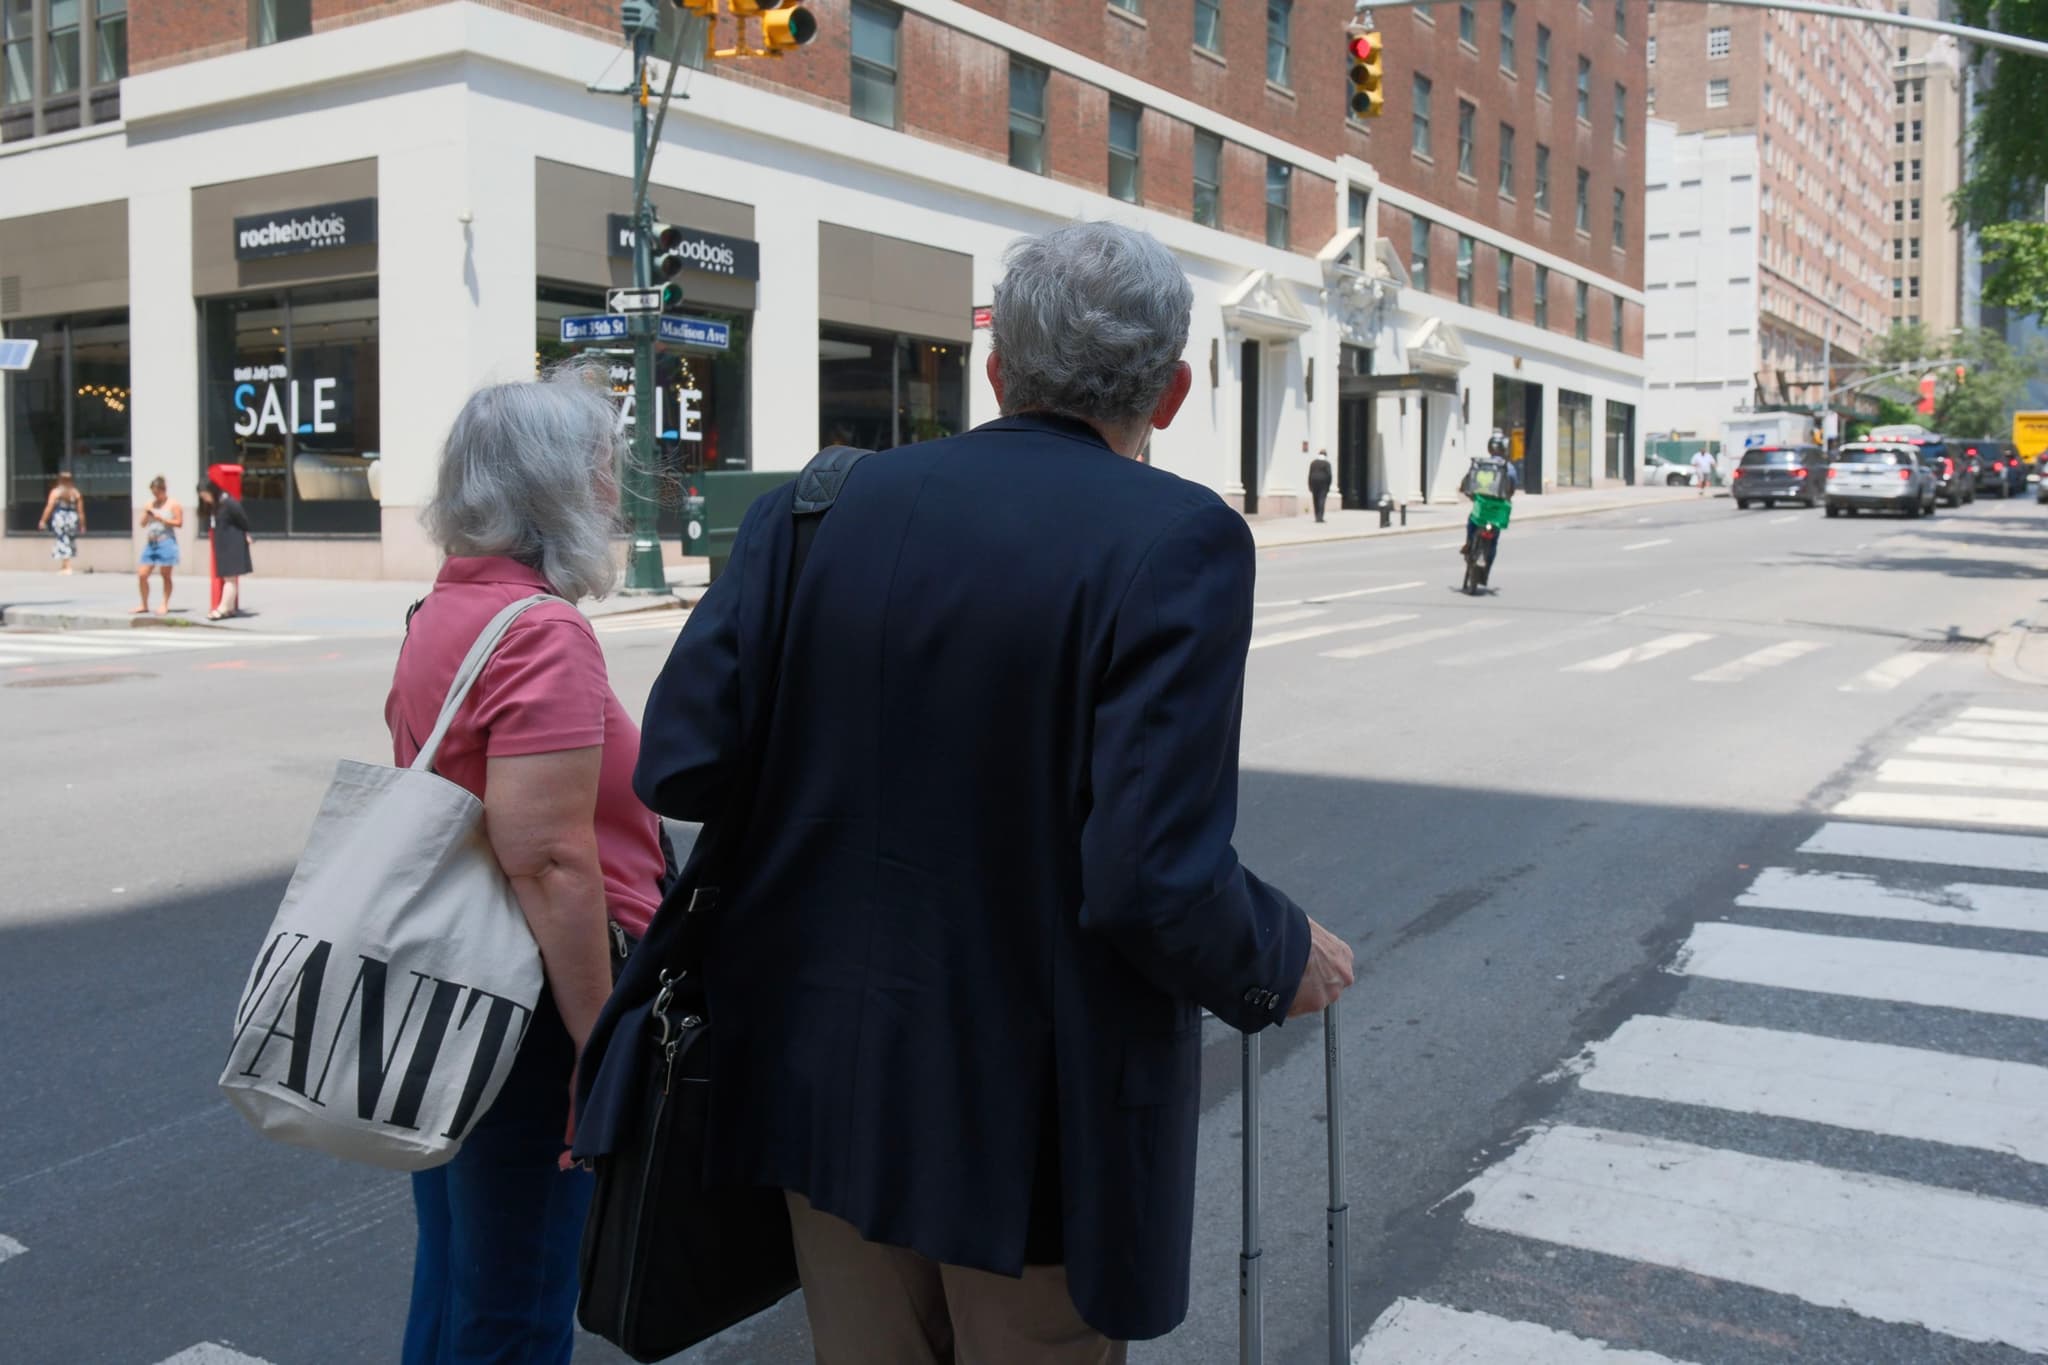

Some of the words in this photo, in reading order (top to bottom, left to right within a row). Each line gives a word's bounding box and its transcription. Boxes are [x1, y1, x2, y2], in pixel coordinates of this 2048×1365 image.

[240, 212, 346, 248] rochebobois
[565, 321, 587, 338] East
[612, 318, 625, 335] St
[660, 319, 706, 341] Madison
[706, 327, 727, 344] Ave
[233, 377, 337, 437] SALE
[614, 385, 703, 441] ALE
